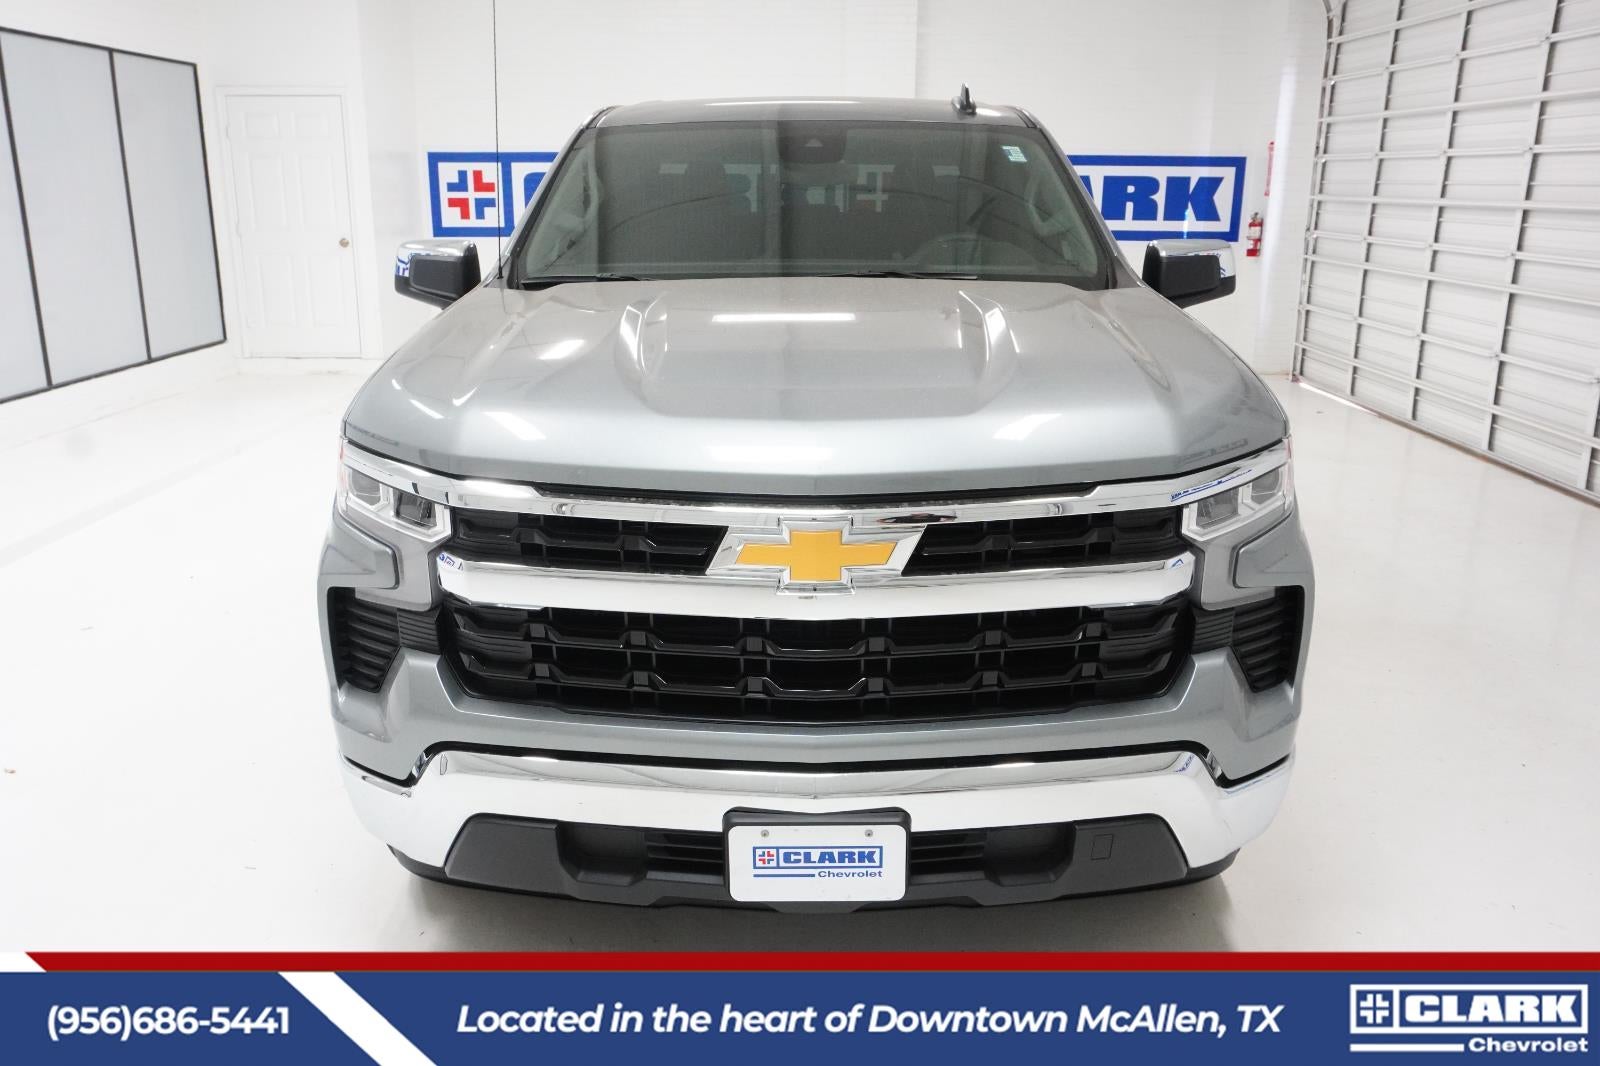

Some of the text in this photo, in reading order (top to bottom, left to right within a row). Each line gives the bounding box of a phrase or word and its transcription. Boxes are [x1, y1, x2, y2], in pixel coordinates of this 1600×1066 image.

[1080, 175, 1224, 222] RK
[782, 850, 877, 864] CLARK
[817, 870, 883, 878] Chevrolet
